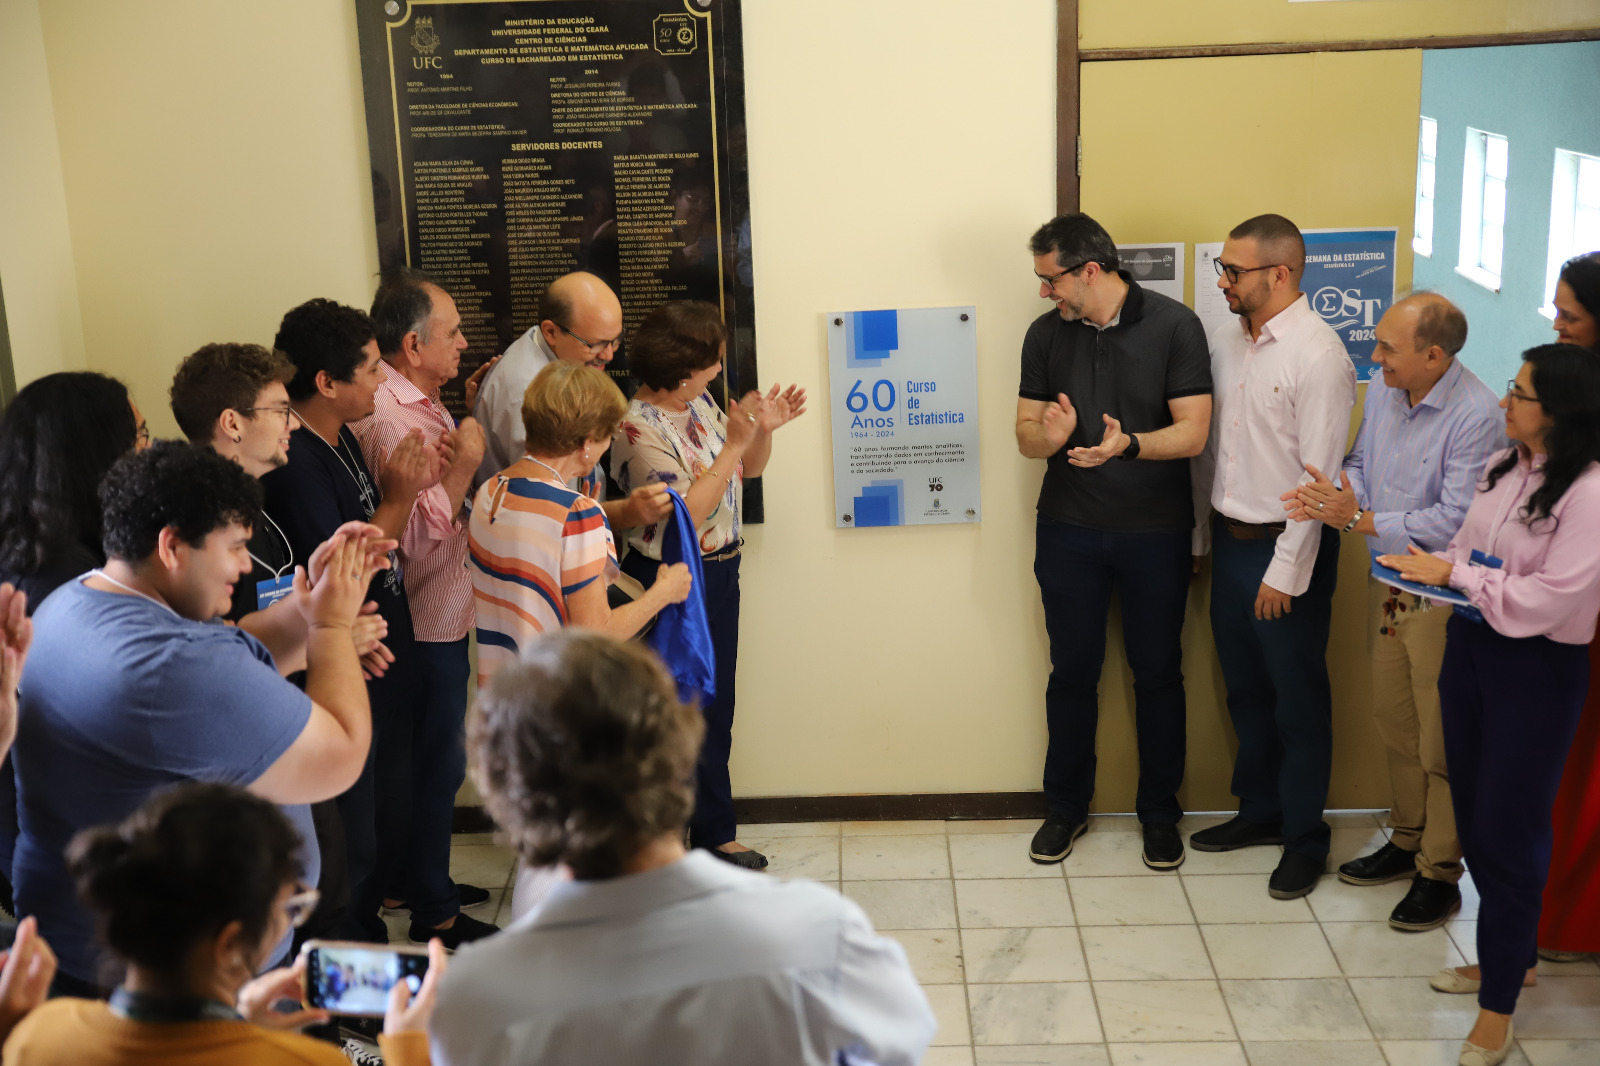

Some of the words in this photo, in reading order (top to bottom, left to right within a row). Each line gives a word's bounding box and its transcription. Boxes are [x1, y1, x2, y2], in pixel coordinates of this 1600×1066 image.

[412, 56, 443, 69] UFC
[511, 142, 560, 151] SERVIDORES
[562, 141, 603, 150] DOCENTES
[1305, 255, 1331, 263] SEMANA
[1344, 251, 1385, 261] ESTATÍSTICA
[1349, 329, 1376, 341] 2024
[907, 381, 936, 393] Curso
[846, 379, 895, 413] 60
[908, 397, 920, 409] de
[850, 414, 894, 429] Anos
